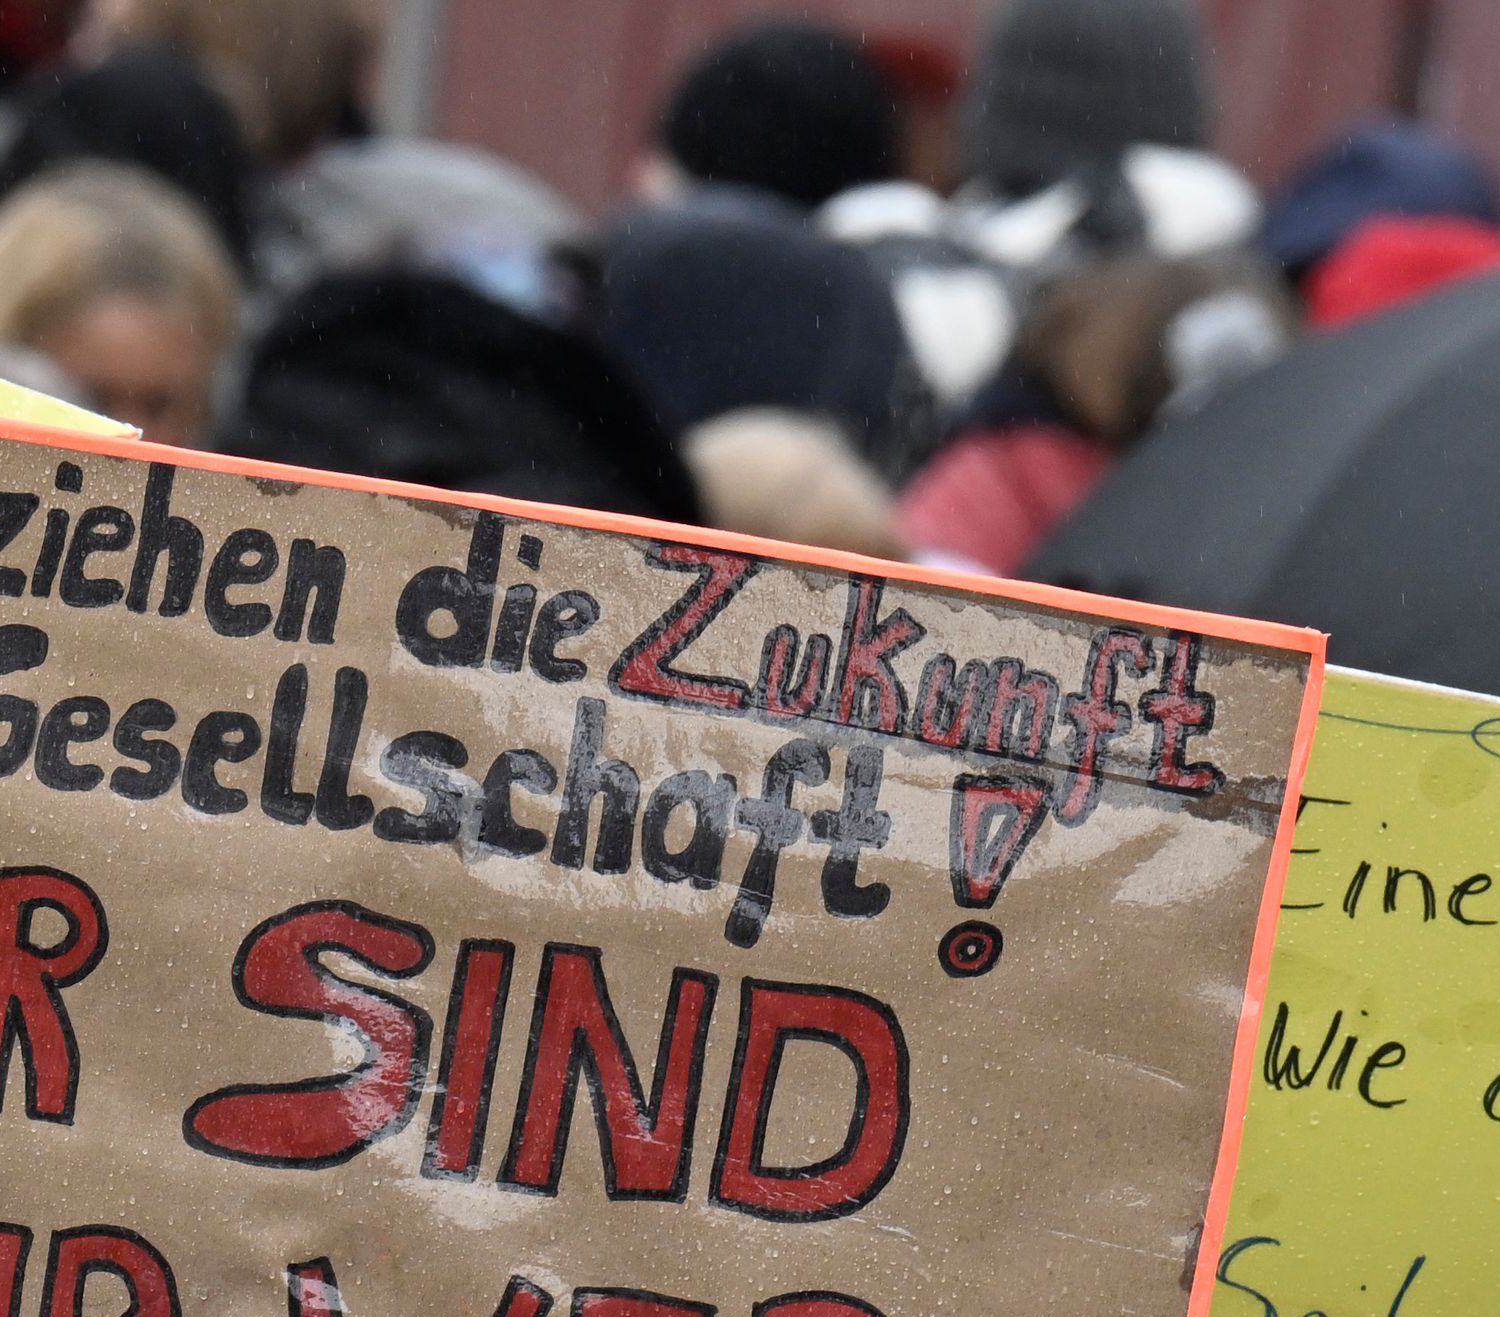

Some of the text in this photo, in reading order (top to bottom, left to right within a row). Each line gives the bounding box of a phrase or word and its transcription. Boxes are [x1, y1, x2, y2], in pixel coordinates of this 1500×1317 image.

[396, 512, 600, 683] die
[609, 540, 1227, 829] Zukunft
[182, 900, 911, 1224] SIND
